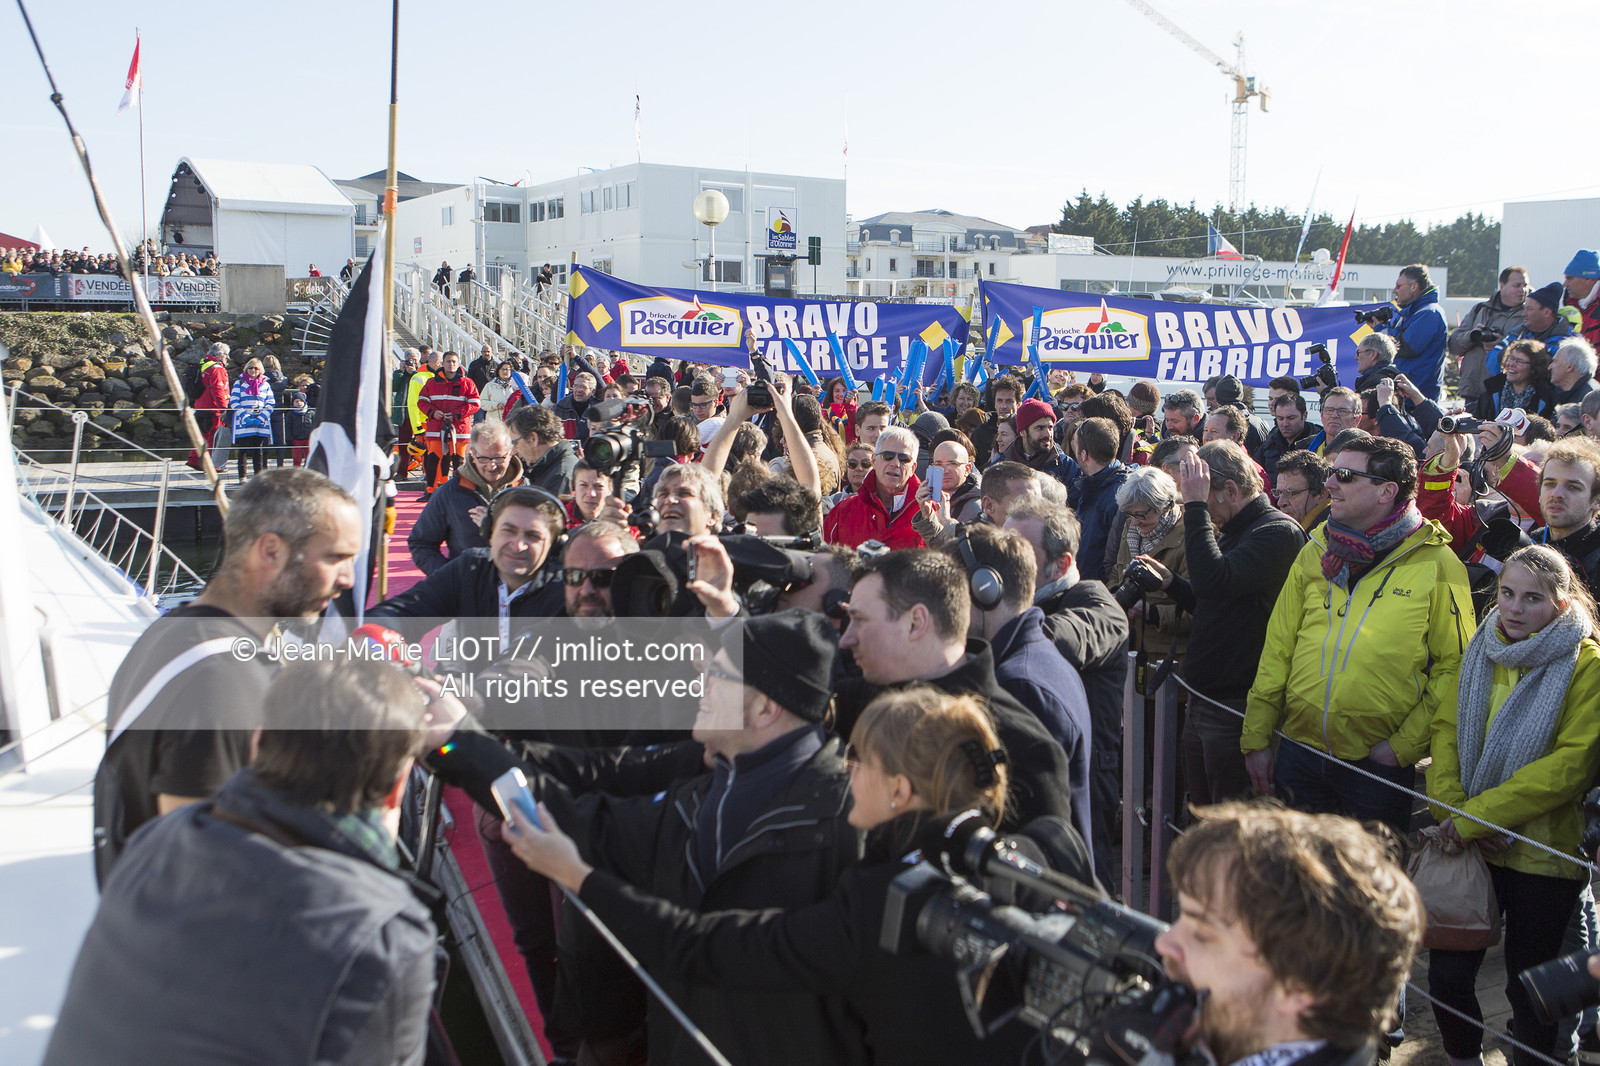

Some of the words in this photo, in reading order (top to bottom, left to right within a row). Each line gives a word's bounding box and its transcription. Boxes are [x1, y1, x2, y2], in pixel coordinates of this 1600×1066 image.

[86, 279, 131, 291] VENDÉE
[175, 281, 217, 292] VENDÉE
[630, 310, 735, 341] Pasquier
[649, 311, 678, 321] brioche
[745, 302, 879, 338] BRAVO
[1154, 307, 1304, 350] BRAVO
[1037, 325, 1139, 355] Pasquier
[1053, 327, 1081, 336] brioche
[1156, 343, 1313, 382] FABRICE
